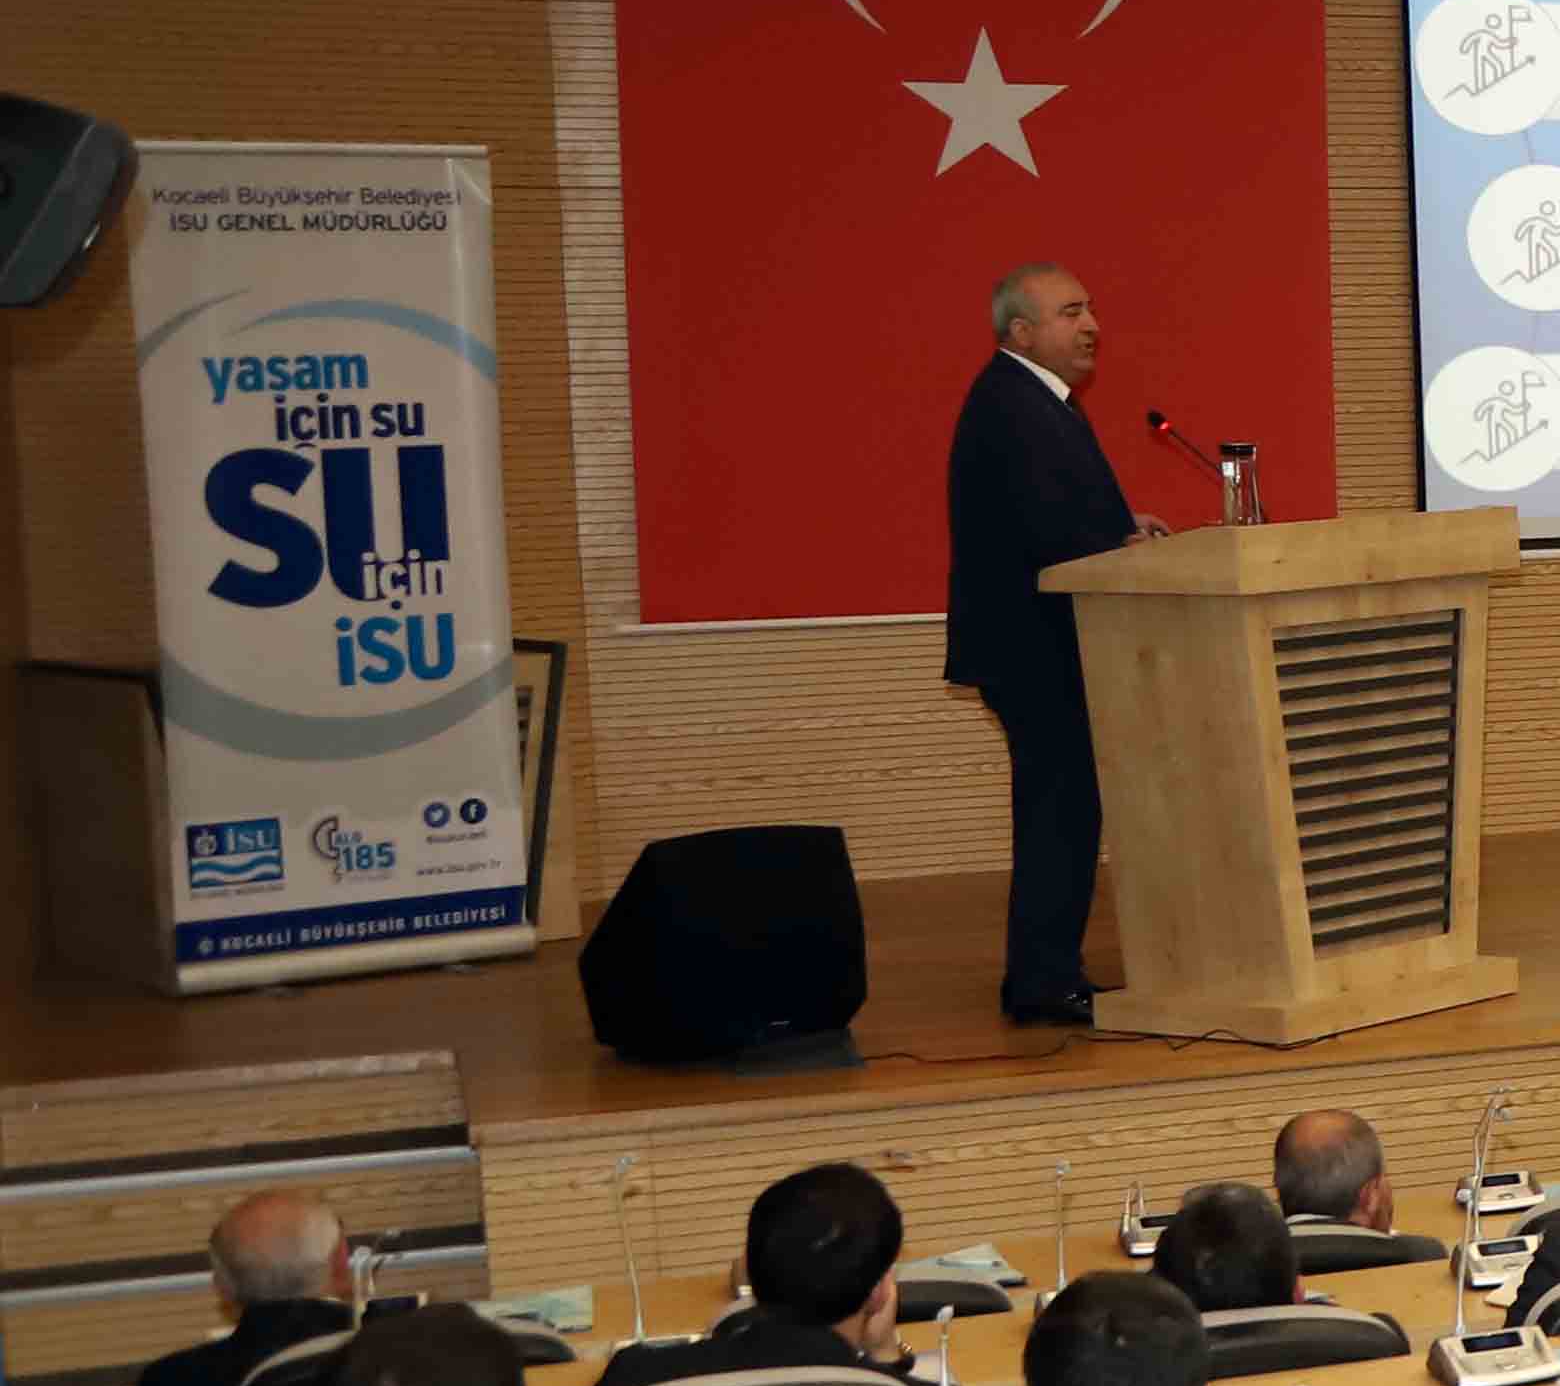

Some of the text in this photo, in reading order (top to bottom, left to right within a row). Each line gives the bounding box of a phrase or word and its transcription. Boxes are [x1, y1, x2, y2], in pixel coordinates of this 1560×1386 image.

[152, 187, 230, 205] Kocaeli
[360, 187, 461, 208] Belediyesi
[217, 214, 296, 231] GENEL
[302, 211, 448, 231] MÜDÜRLÜĞÜ
[274, 393, 425, 450] için su
[205, 445, 450, 608] SU
[227, 826, 276, 851] İSU
[339, 842, 395, 871] 185
[220, 931, 291, 951] KOCAELİ
